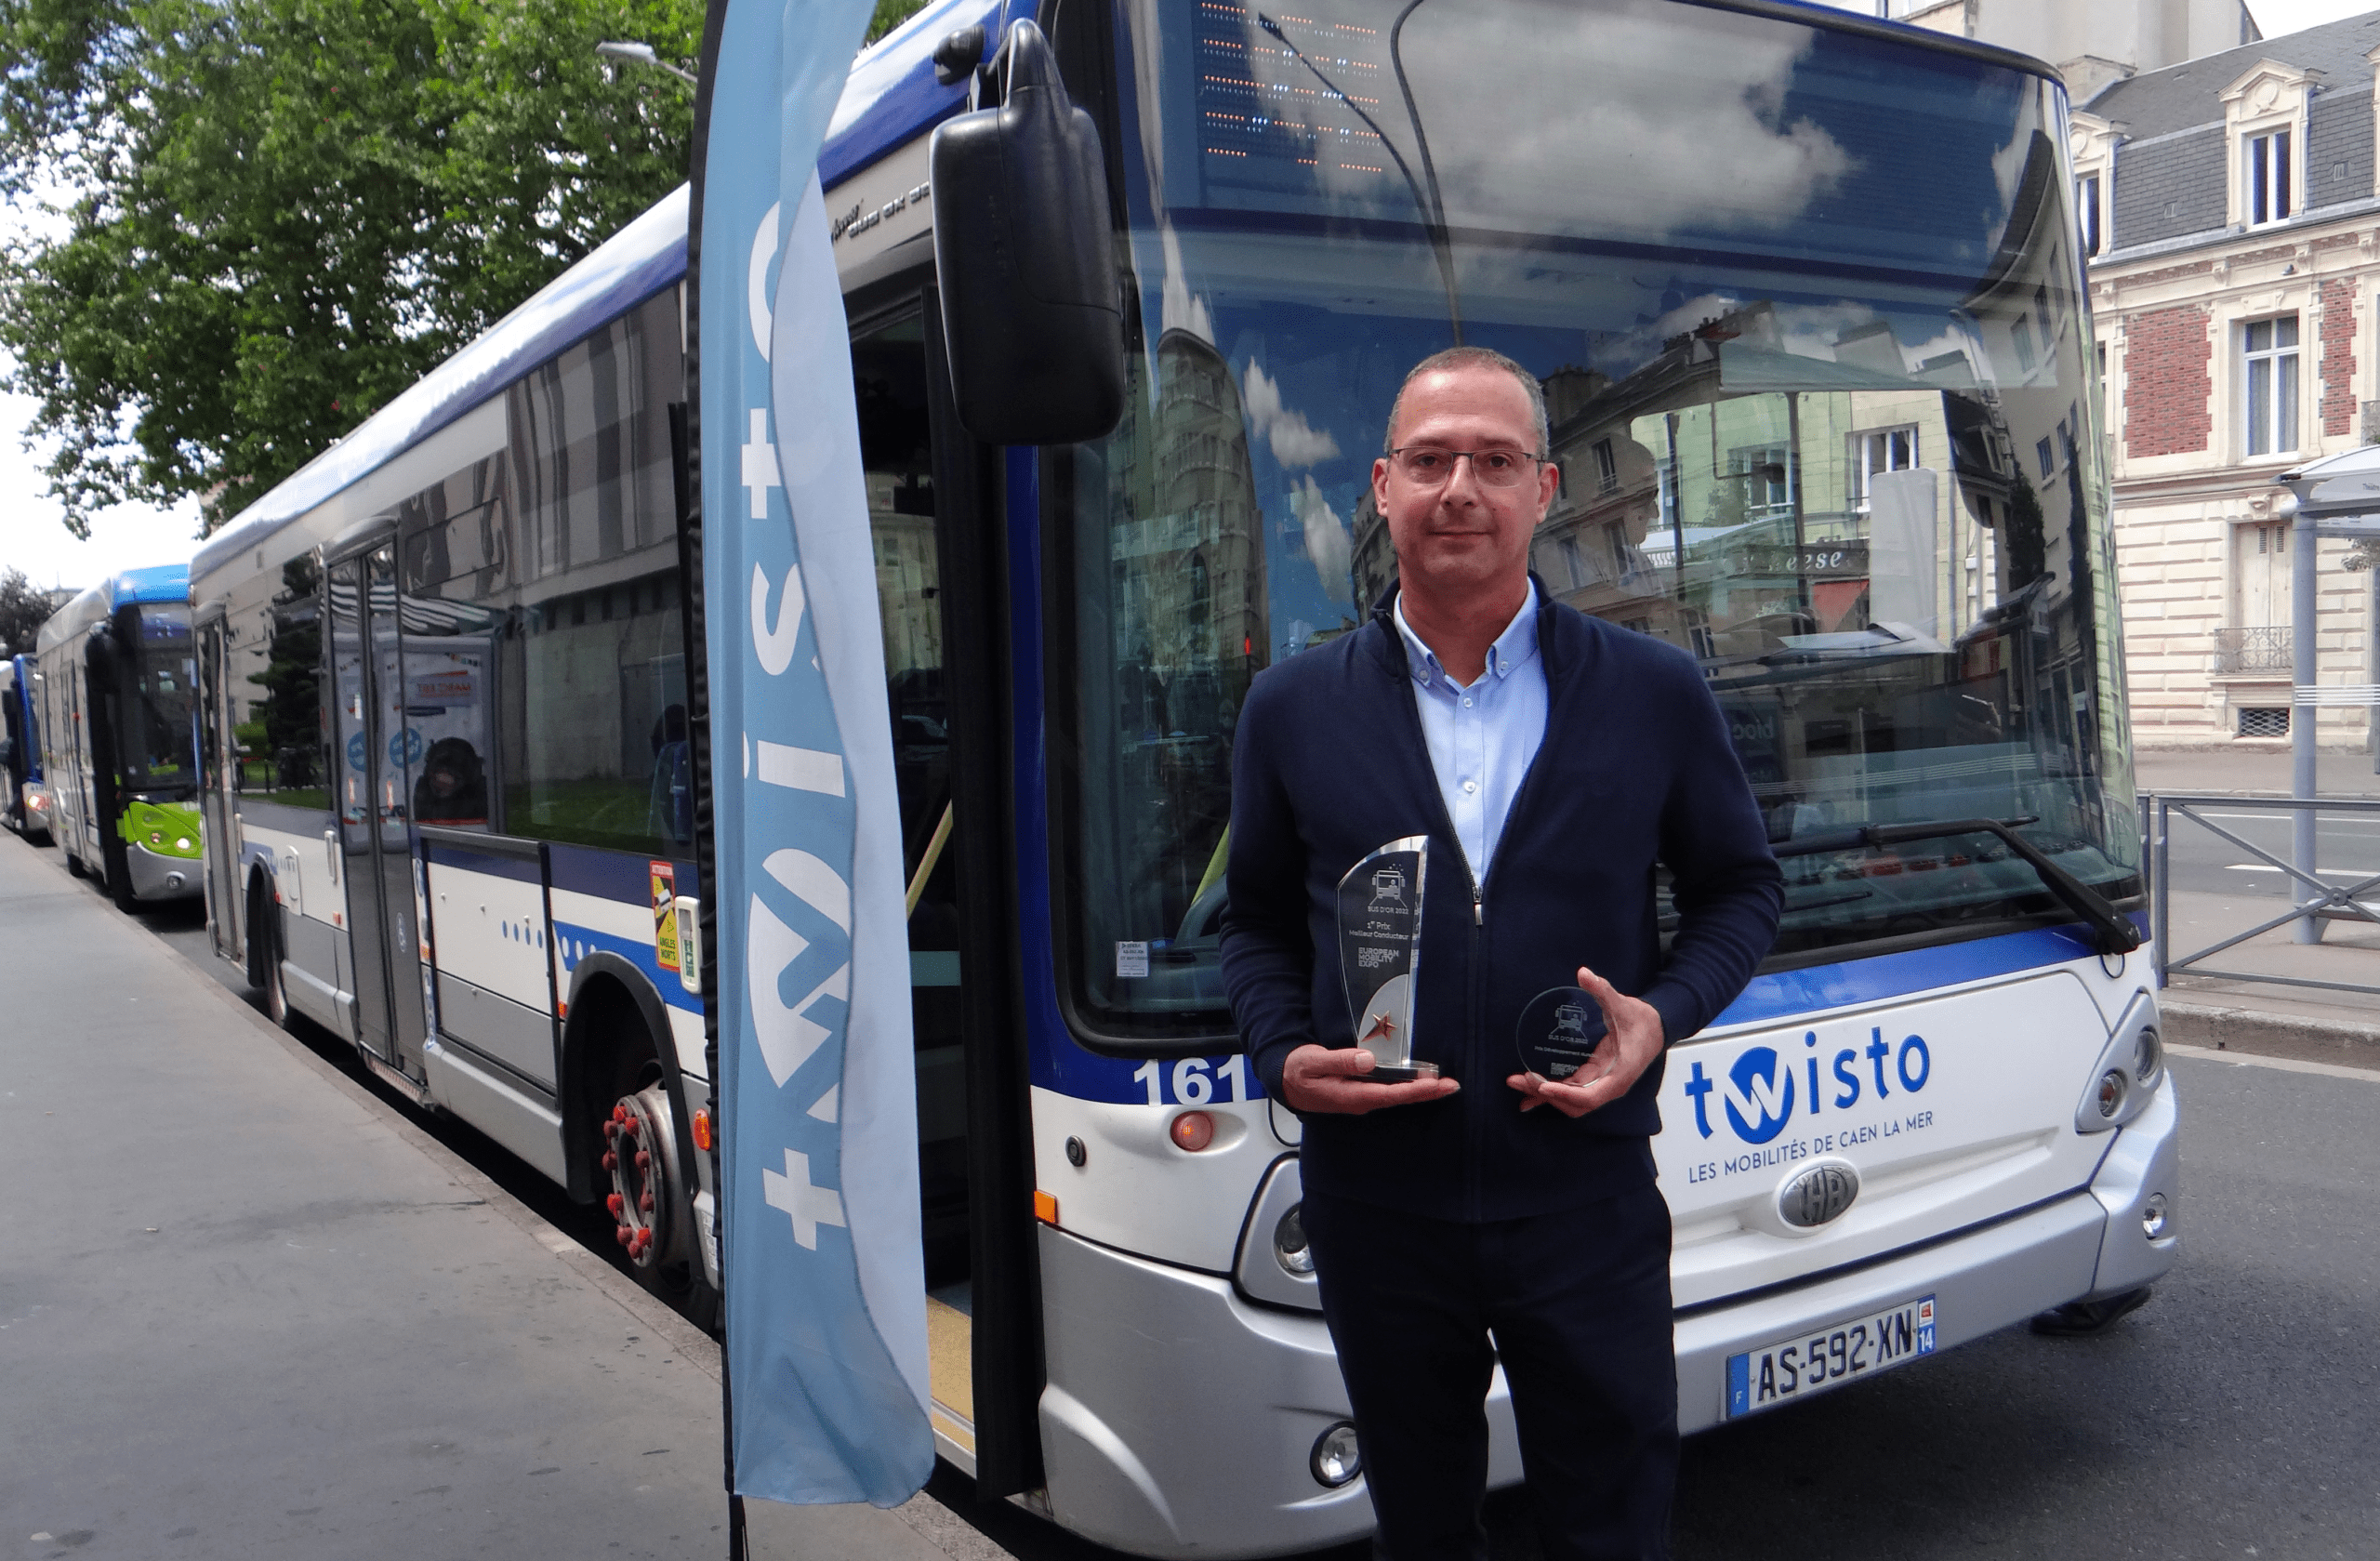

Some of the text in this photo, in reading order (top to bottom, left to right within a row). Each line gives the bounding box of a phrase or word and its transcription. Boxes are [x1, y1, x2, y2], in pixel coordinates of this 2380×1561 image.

[1373, 931, 1409, 940] Conducteur
[1376, 921, 1391, 930] Prix
[1358, 946, 1399, 957] EUROPEAN
[1358, 954, 1394, 963] MOBILITY
[1133, 1053, 1247, 1107] 161
[1684, 1025, 1930, 1145] twisto
[1688, 1111, 1934, 1184] LES MOBILITÉS DE CAEN LA MER
[1736, 1391, 1742, 1404] F
[1757, 1309, 1911, 1402] AS-592-XN
[1919, 1329, 1933, 1353] 14
